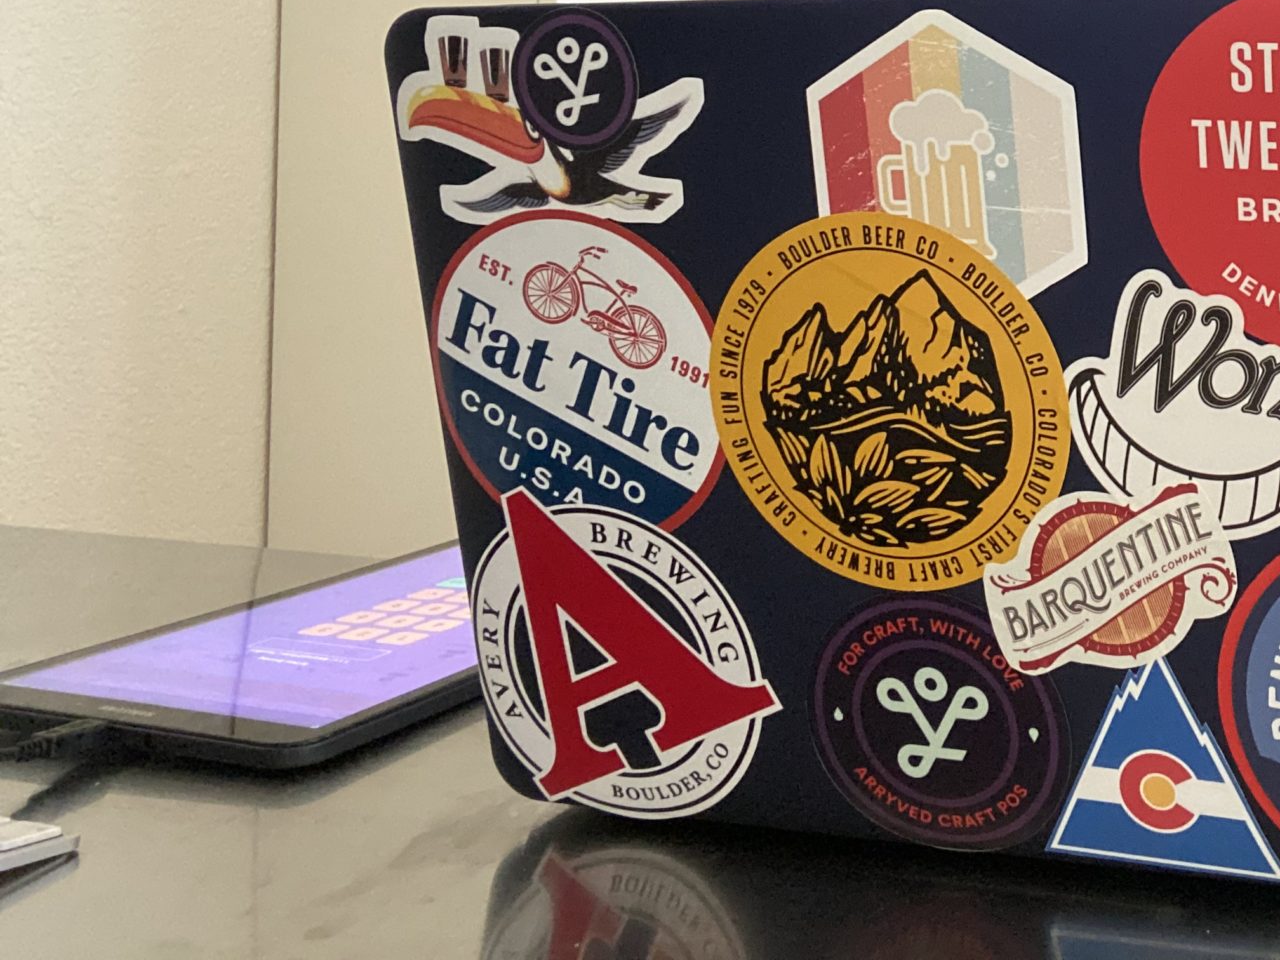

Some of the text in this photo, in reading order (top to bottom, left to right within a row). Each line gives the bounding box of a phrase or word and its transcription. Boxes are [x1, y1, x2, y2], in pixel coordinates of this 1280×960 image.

[478, 253, 514, 286] EST.
[777, 224, 939, 272] BOULDER BEER CO
[669, 355, 709, 389] 1991
[960, 262, 1049, 379] BOULDER, CO
[445, 287, 700, 472] Fat Tire
[718, 278, 795, 527] CRAFTING FUN SINCE 1979
[459, 389, 646, 504] COLORADO
[813, 407, 1058, 583] COLORADO'S FIRST CRAFT BREWERY
[589, 521, 741, 664] BREWING
[1001, 501, 1214, 644] BARQUENTINE
[1118, 545, 1209, 602] BREWING COMPANY
[481, 598, 524, 720] AVERY
[503, 488, 778, 797] A
[837, 616, 1025, 692] FOR CRAFT, WITH LOVE
[853, 766, 1029, 829] ARRYVED CRAFT POS
